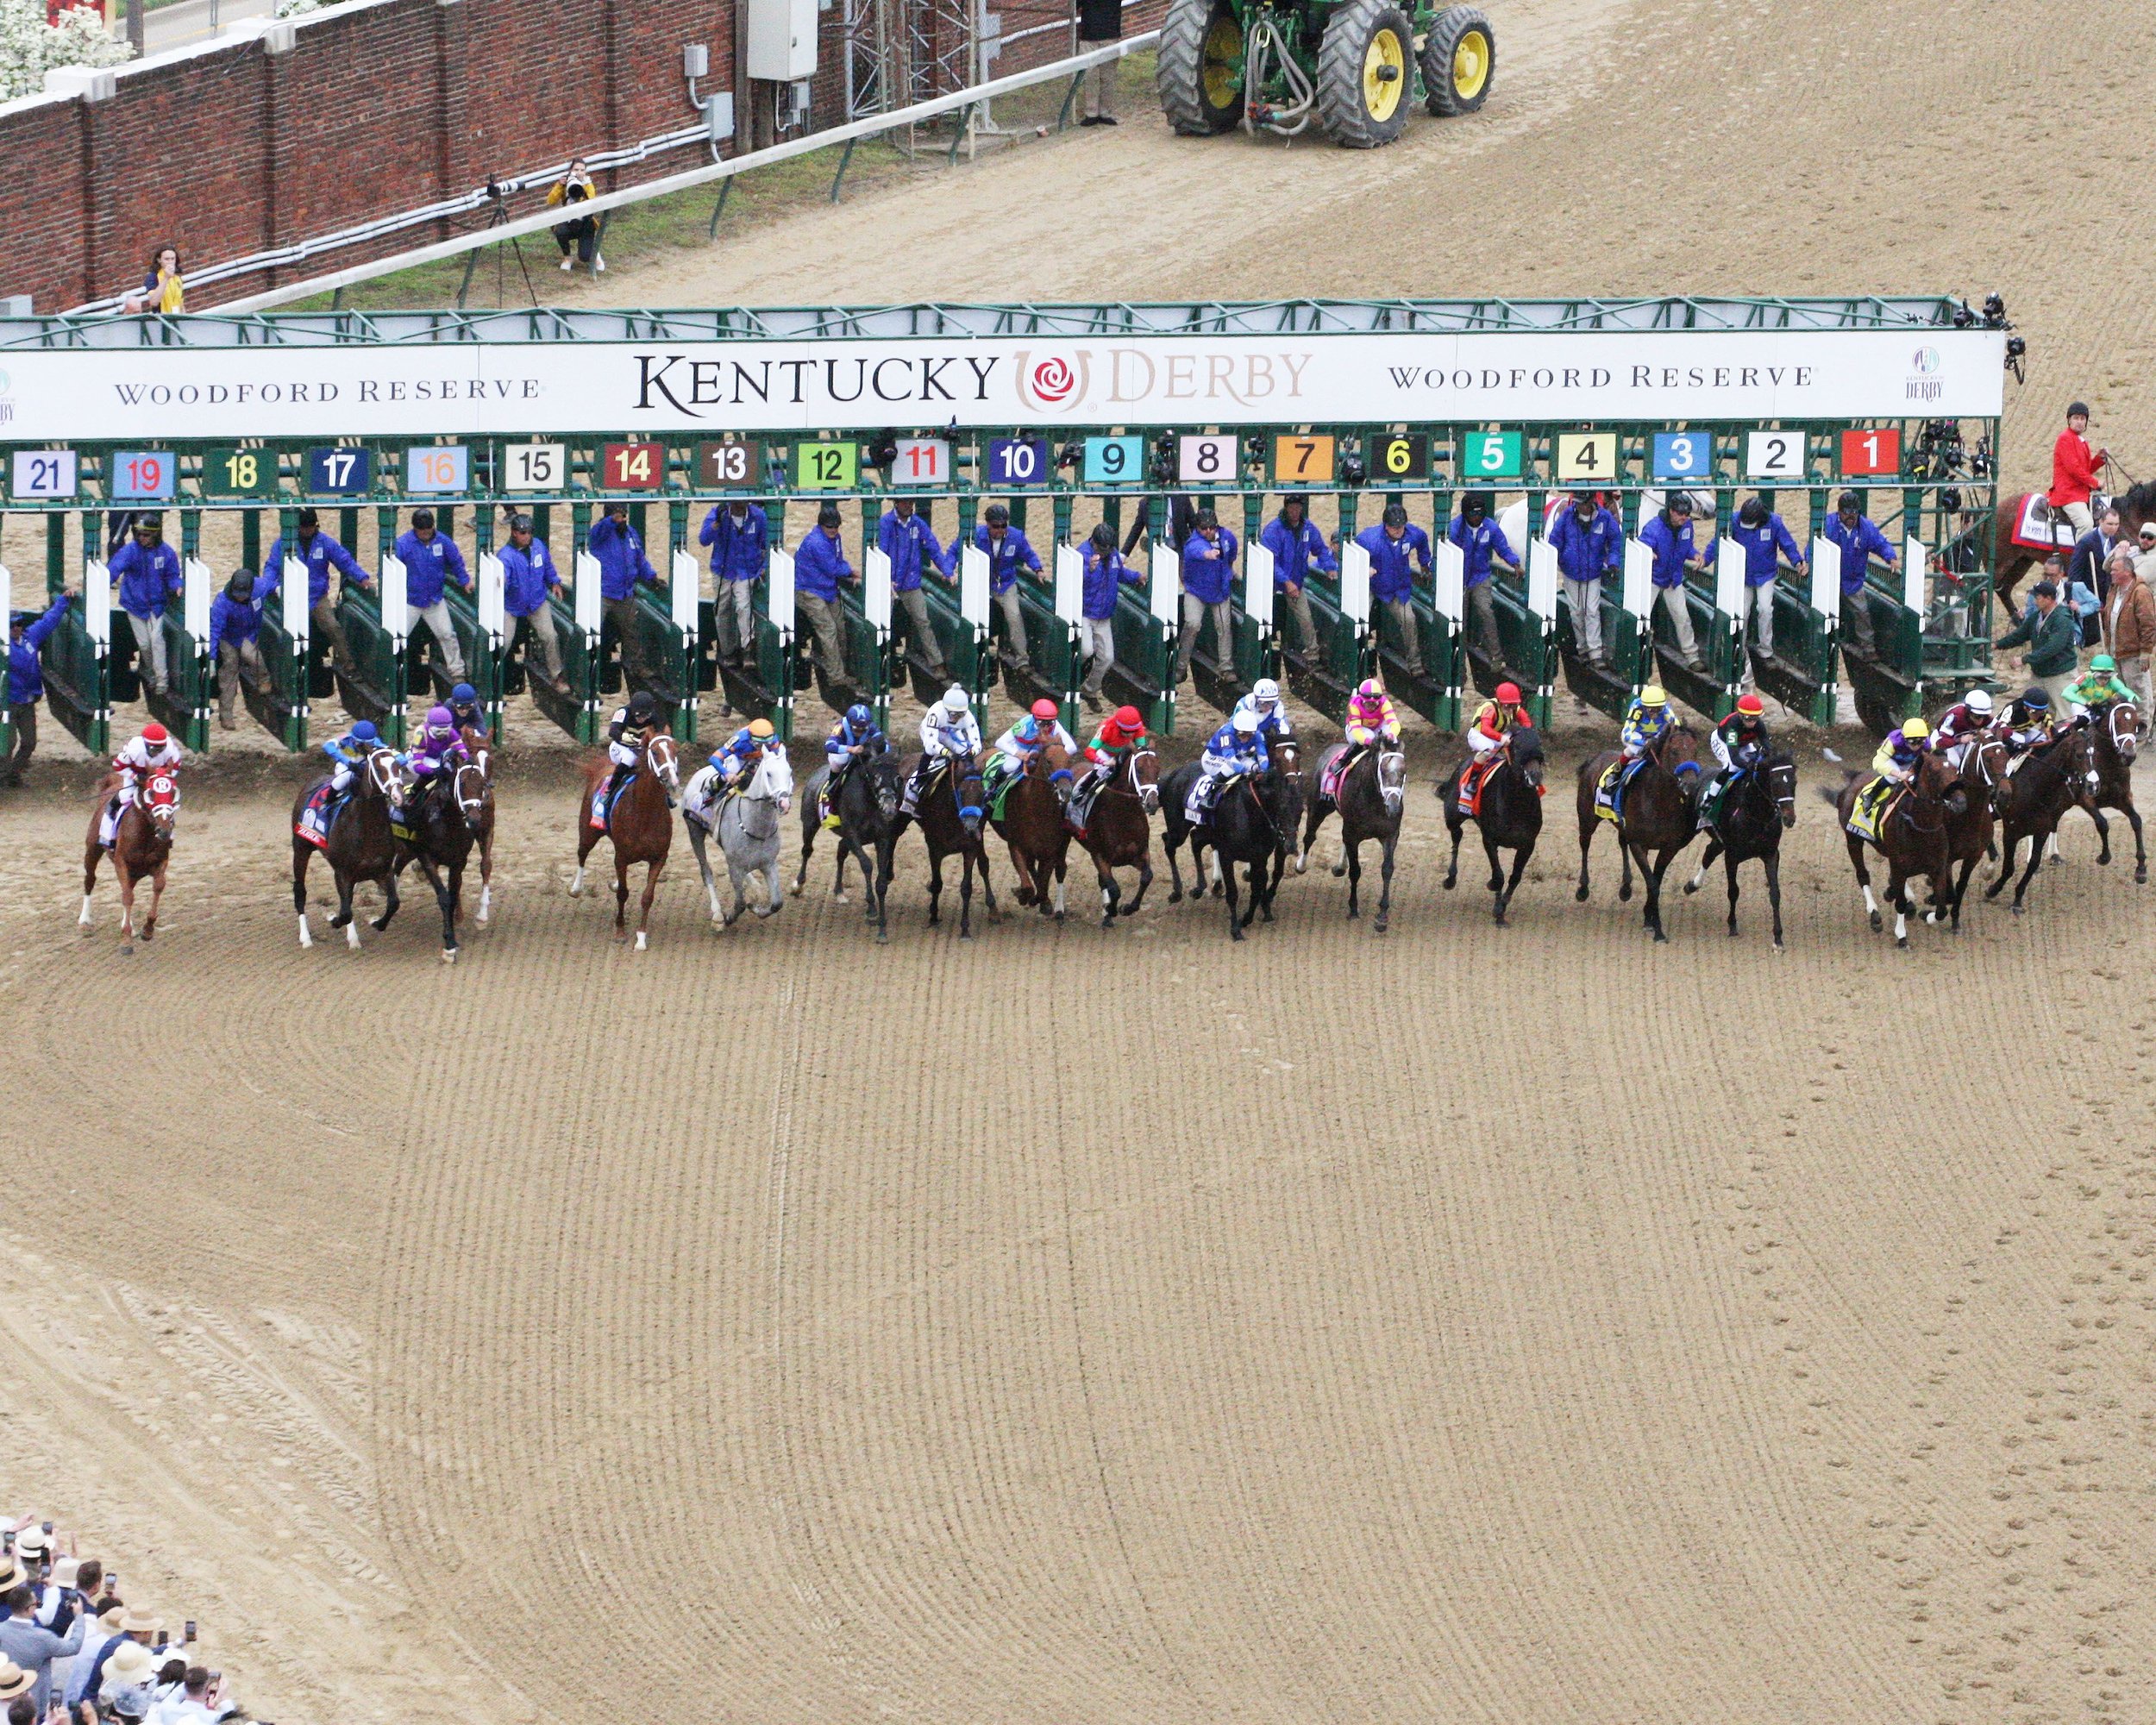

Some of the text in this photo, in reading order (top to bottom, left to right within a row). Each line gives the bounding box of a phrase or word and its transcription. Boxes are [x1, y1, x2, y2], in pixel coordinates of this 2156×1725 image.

[115, 380, 539, 405] WOODFORD RESERVE
[632, 348, 1313, 418] KENTUCKY DERBY
[1388, 365, 1812, 389] WOODFORD RESERVE
[1906, 381, 1943, 403] DERBY
[518, 451, 551, 482] 15
[614, 449, 650, 482] 14
[711, 447, 746, 480] 13
[812, 450, 843, 480] 12
[906, 445, 936, 477] 11
[1000, 444, 1035, 479] 10
[1101, 443, 1125, 474] 9
[1196, 442, 1219, 474] 8
[1294, 443, 1315, 474] 7
[1385, 440, 1411, 474] 6
[1481, 437, 1505, 470] 5
[1575, 441, 1598, 470] 4
[1670, 438, 1693, 471] 3
[1765, 439, 1787, 469] 2
[1862, 436, 1877, 468] 1
[30, 459, 59, 490] 21
[127, 458, 160, 491] 19
[225, 455, 258, 488] 18
[323, 454, 356, 487] 17
[420, 453, 455, 485] 16
[1219, 735, 1230, 748] 10
[1727, 731, 1736, 743] 5
